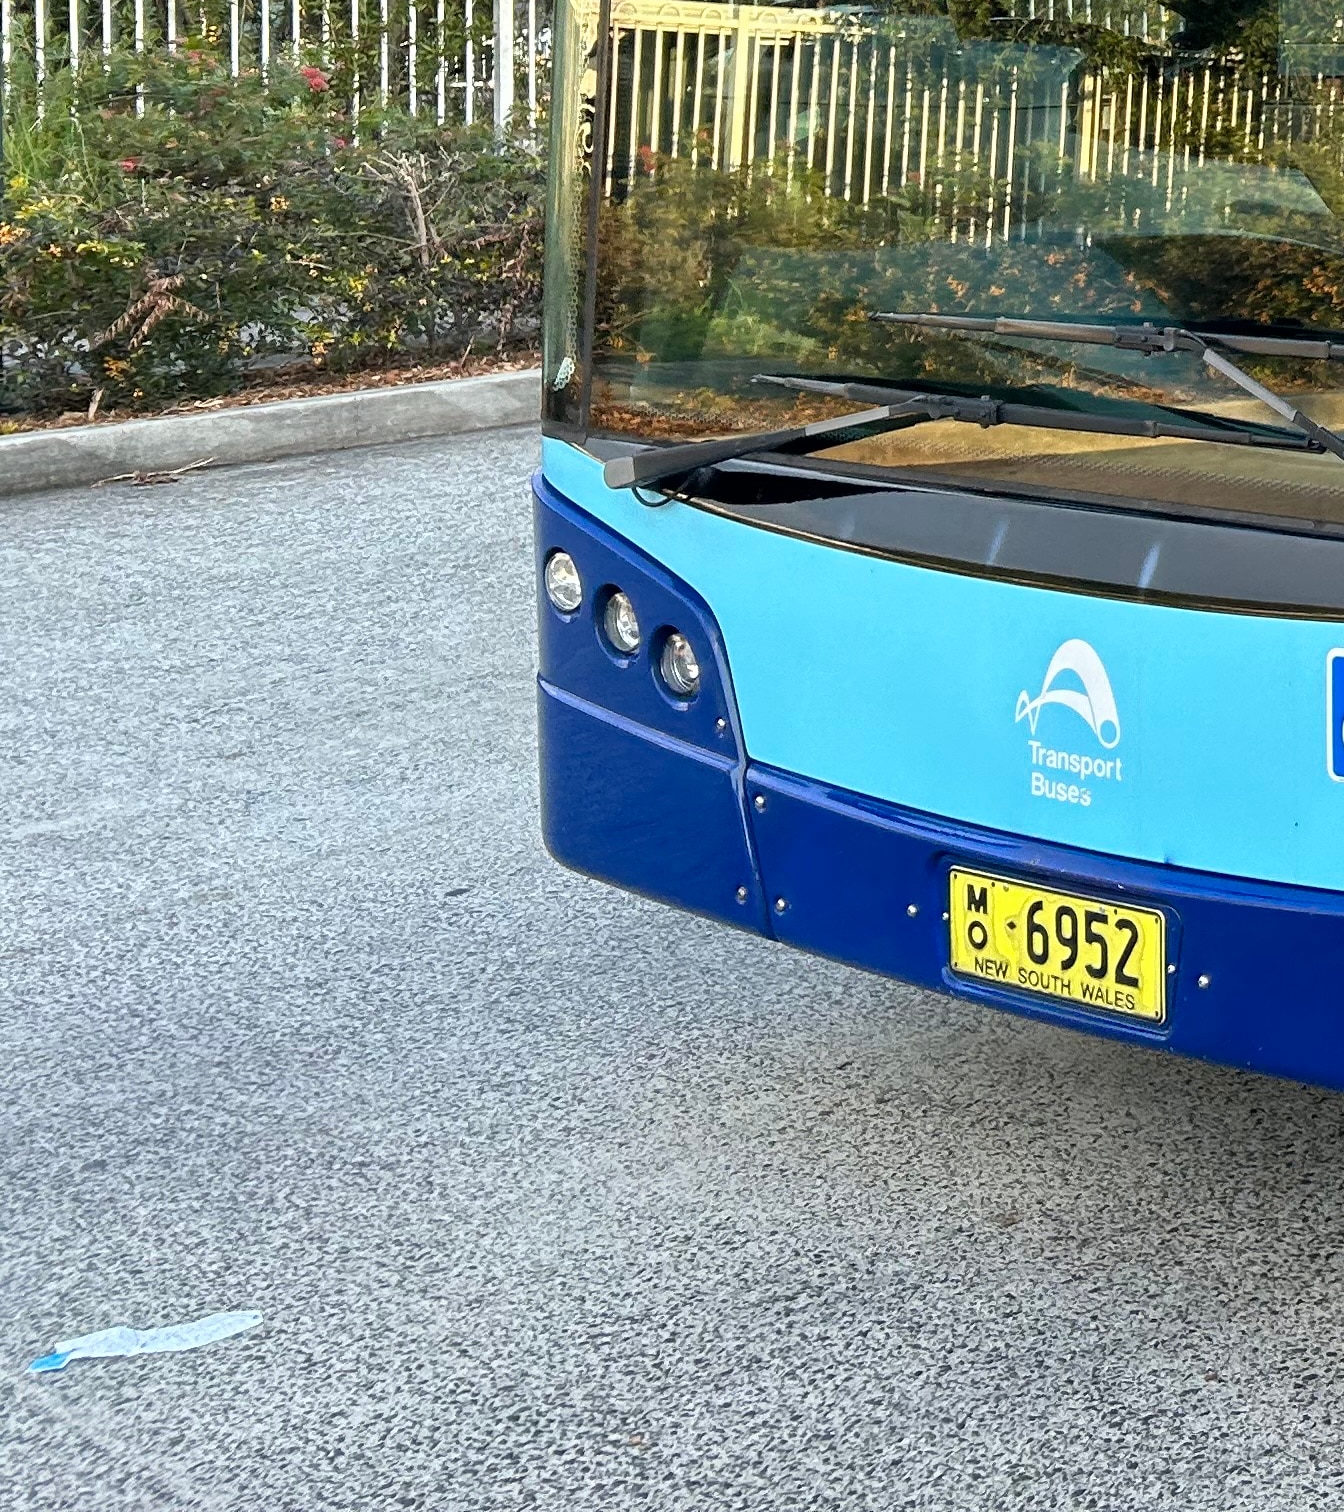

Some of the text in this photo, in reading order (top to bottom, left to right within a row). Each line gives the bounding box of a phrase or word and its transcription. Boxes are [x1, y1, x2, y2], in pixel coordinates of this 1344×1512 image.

[1028, 740, 1122, 781] Transport
[1031, 771, 1092, 806] Buses
[1026, 900, 1139, 988] 6952
[974, 956, 1135, 1010] NEW SOUTH WALES
